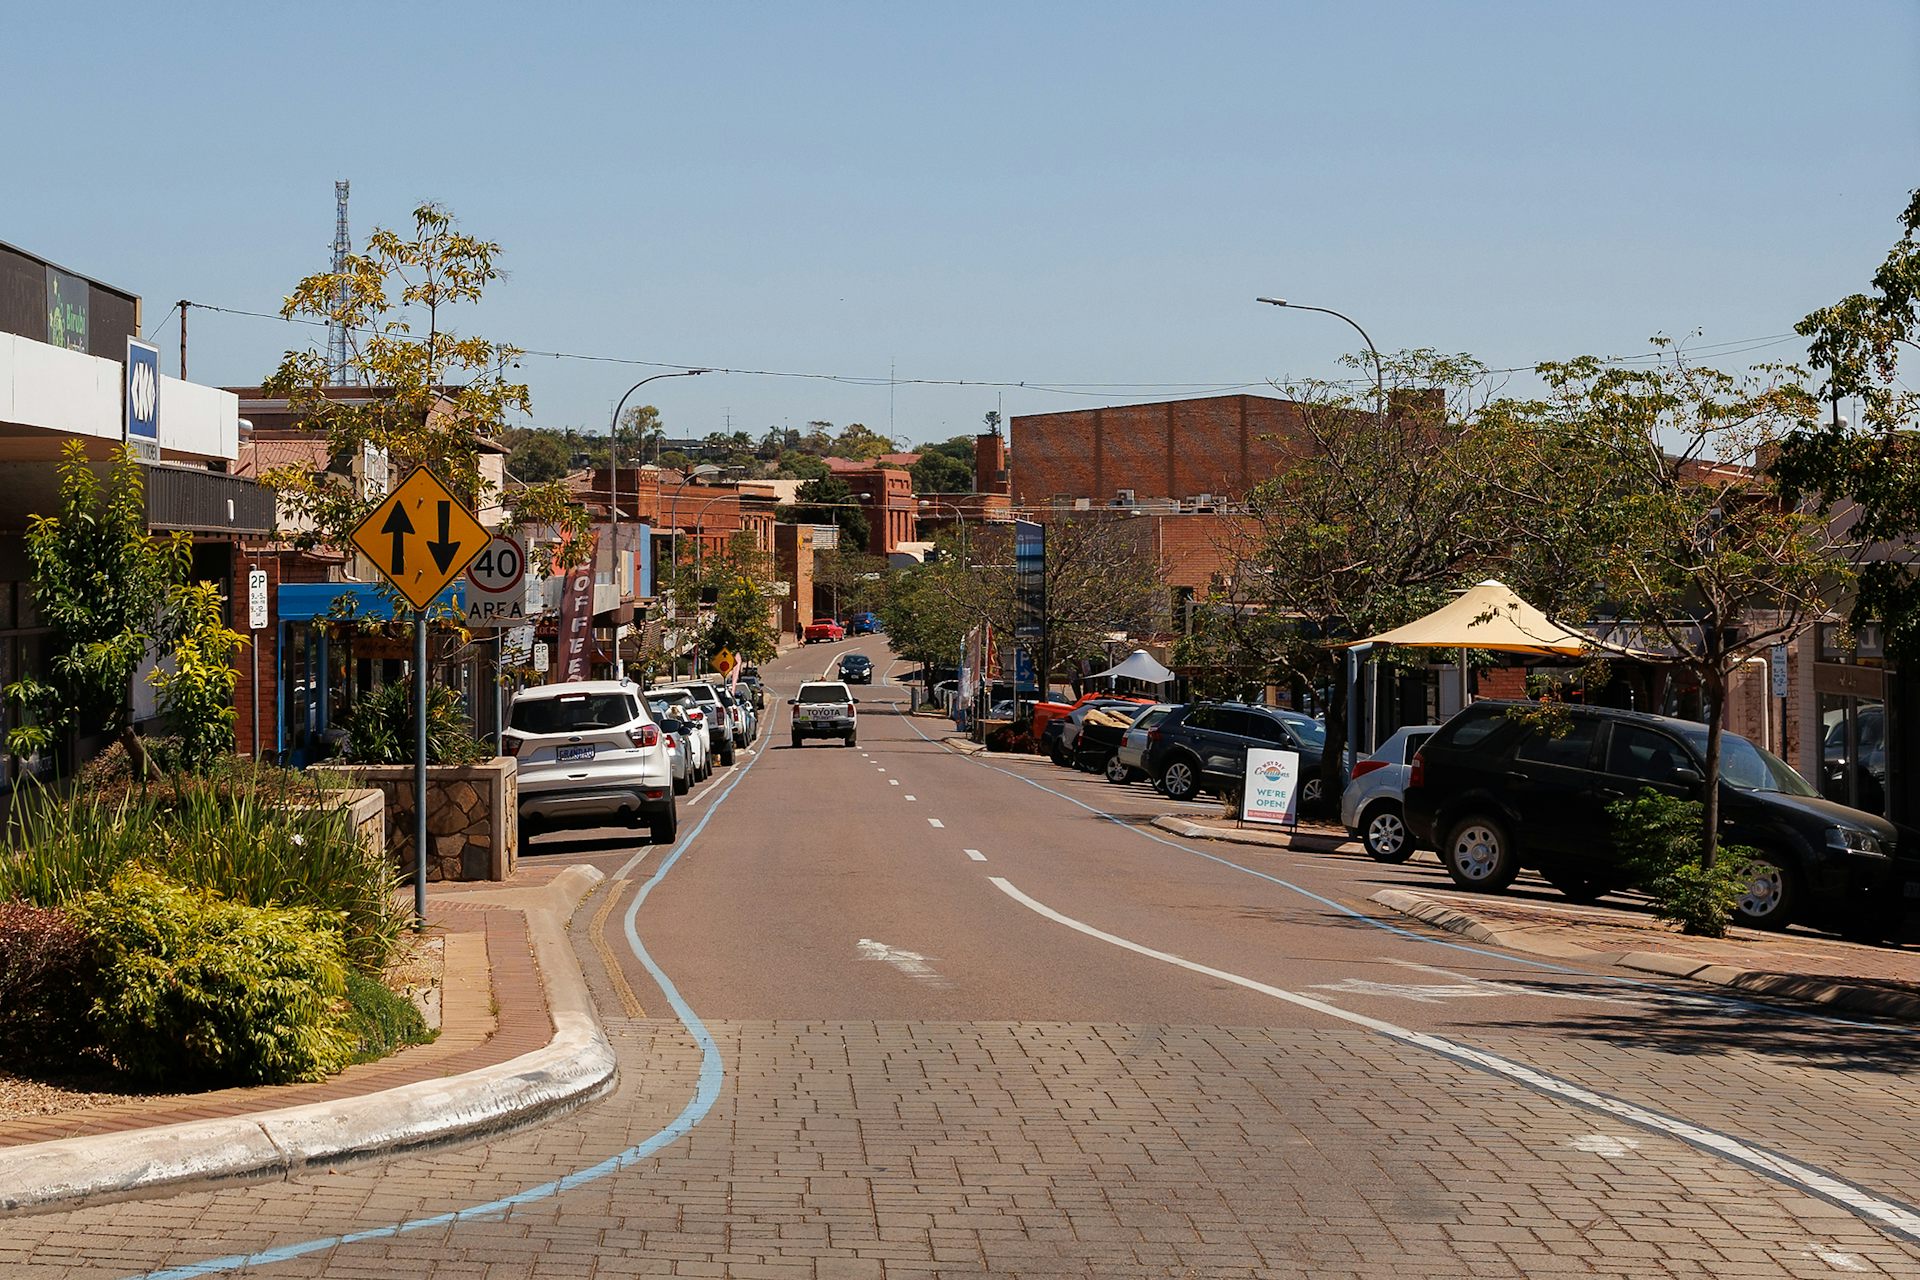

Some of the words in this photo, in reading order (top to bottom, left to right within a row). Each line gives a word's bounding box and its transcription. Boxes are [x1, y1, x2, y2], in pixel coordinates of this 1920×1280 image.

[474, 549, 516, 578] 40
[251, 575, 265, 588] 2P
[469, 602, 522, 619] AREA
[535, 645, 547, 653] 2P
[1021, 651, 1030, 666] P
[807, 707, 840, 716] TOYOTA
[1257, 788, 1286, 798] WE'RE
[1256, 799, 1285, 808] OPEN!
